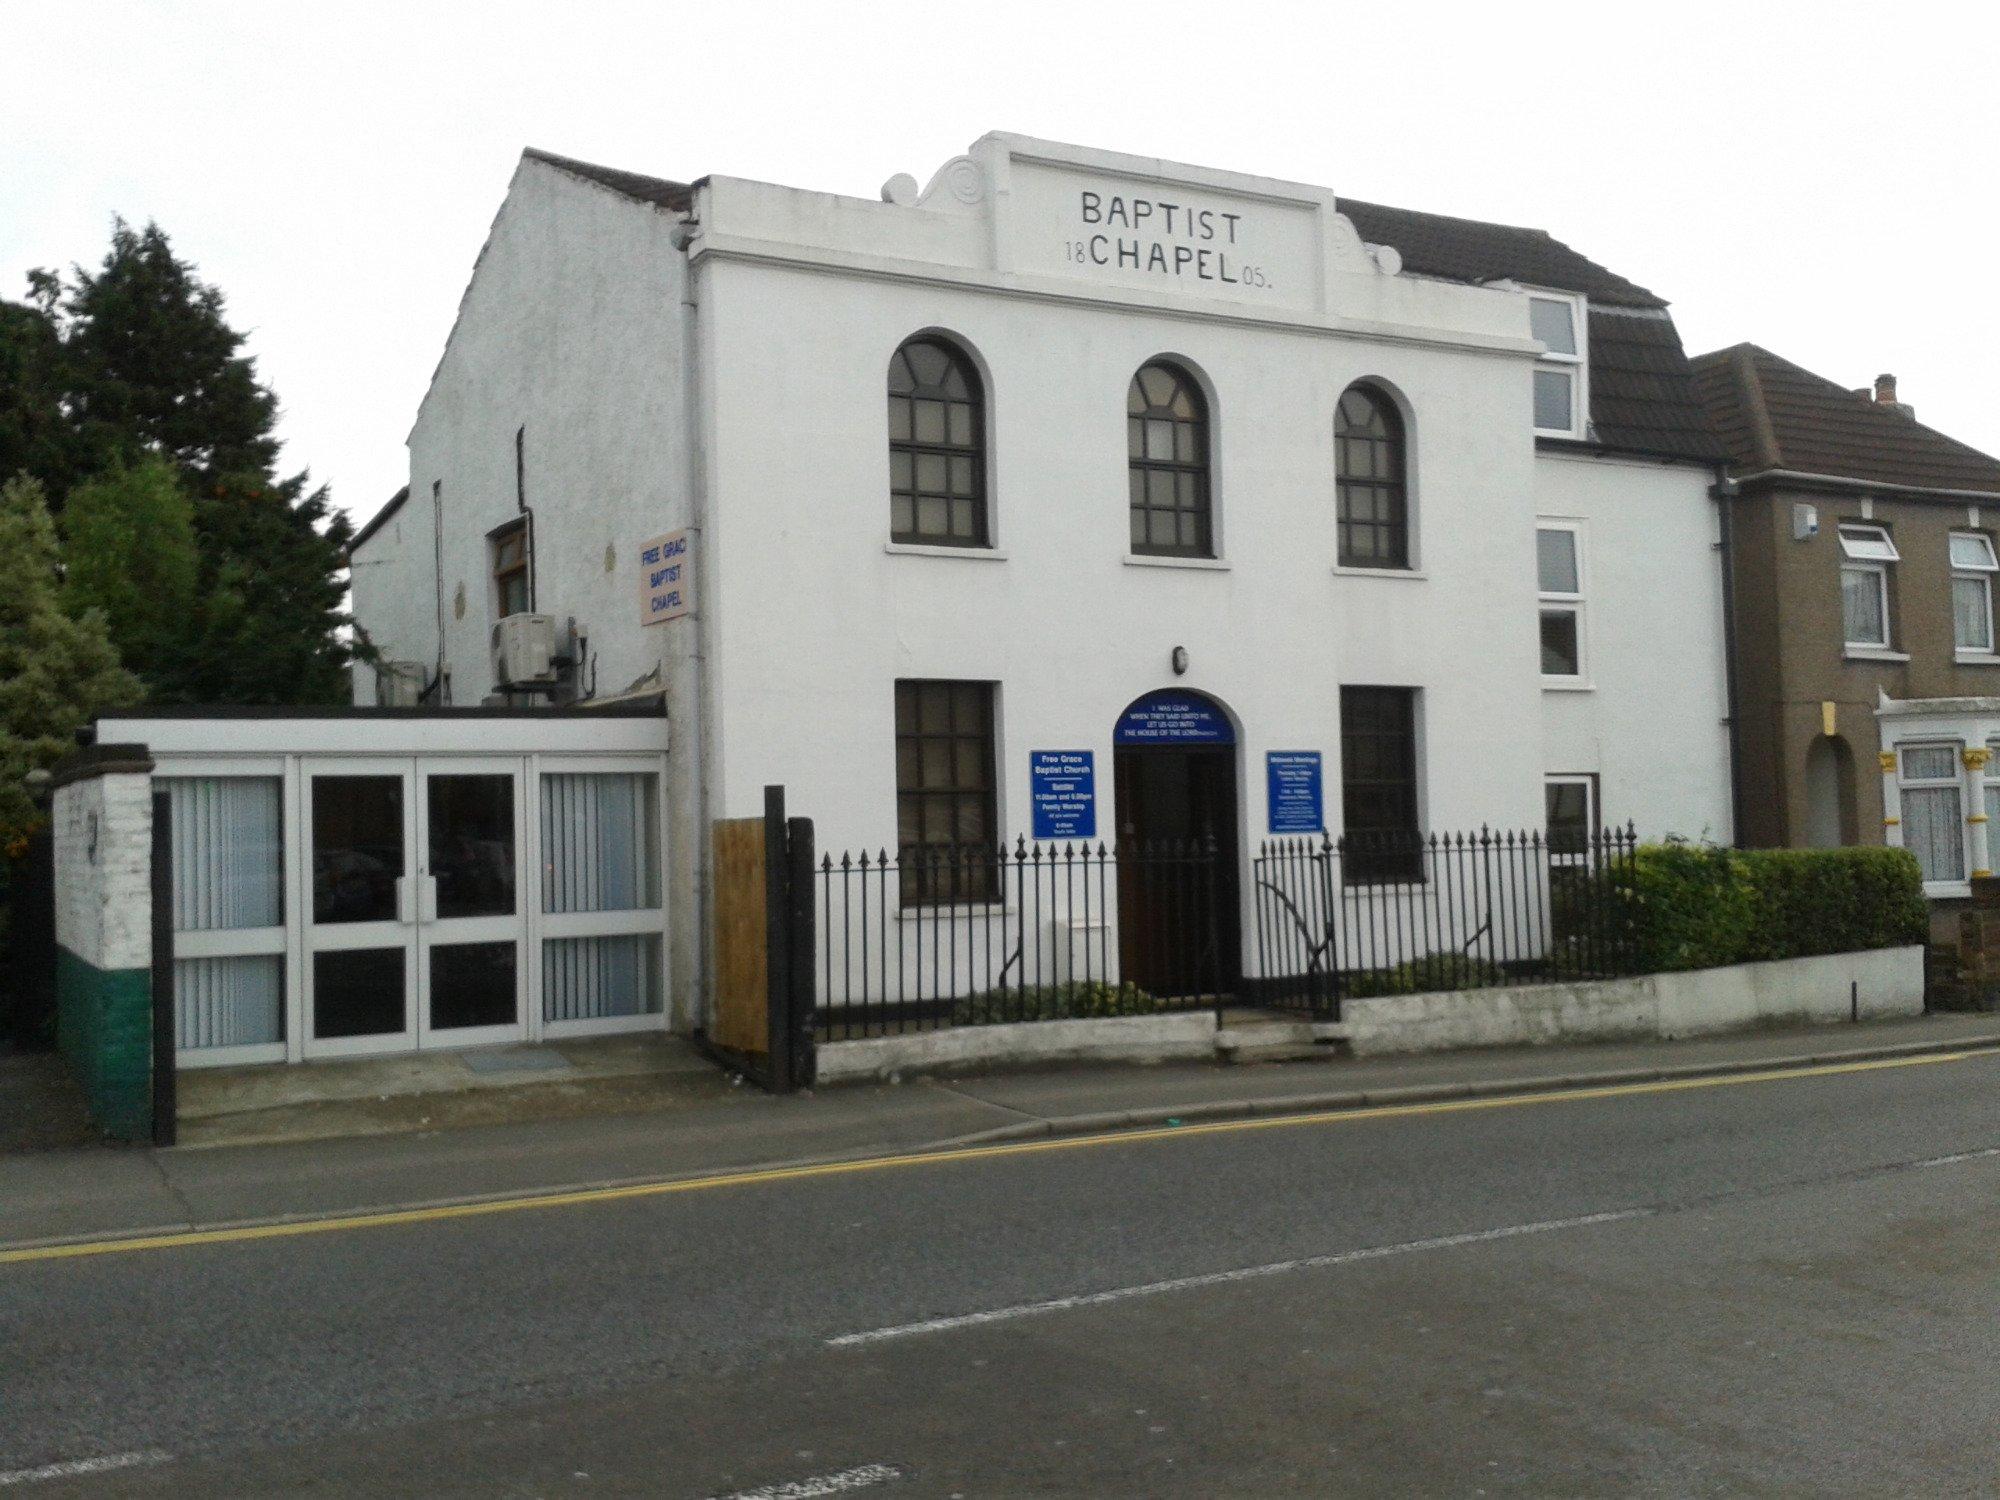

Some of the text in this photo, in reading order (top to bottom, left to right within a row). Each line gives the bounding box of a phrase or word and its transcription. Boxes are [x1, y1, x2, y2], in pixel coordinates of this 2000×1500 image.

[1082, 191, 1241, 243] BAPTIST
[1066, 241, 1086, 263] 18
[1090, 234, 1238, 283] CHAPEL
[642, 546, 660, 566] FREE
[650, 563, 682, 588] BAPTIST
[651, 590, 682, 612] CHAPEL
[1158, 704, 1171, 712] WAS
[1172, 704, 1190, 712] GLAD
[1137, 729, 1159, 737] HOUSE
[1041, 755, 1083, 763] Free Grace
[1035, 765, 1091, 775] Baptist Church
[1058, 793, 1070, 801] and
